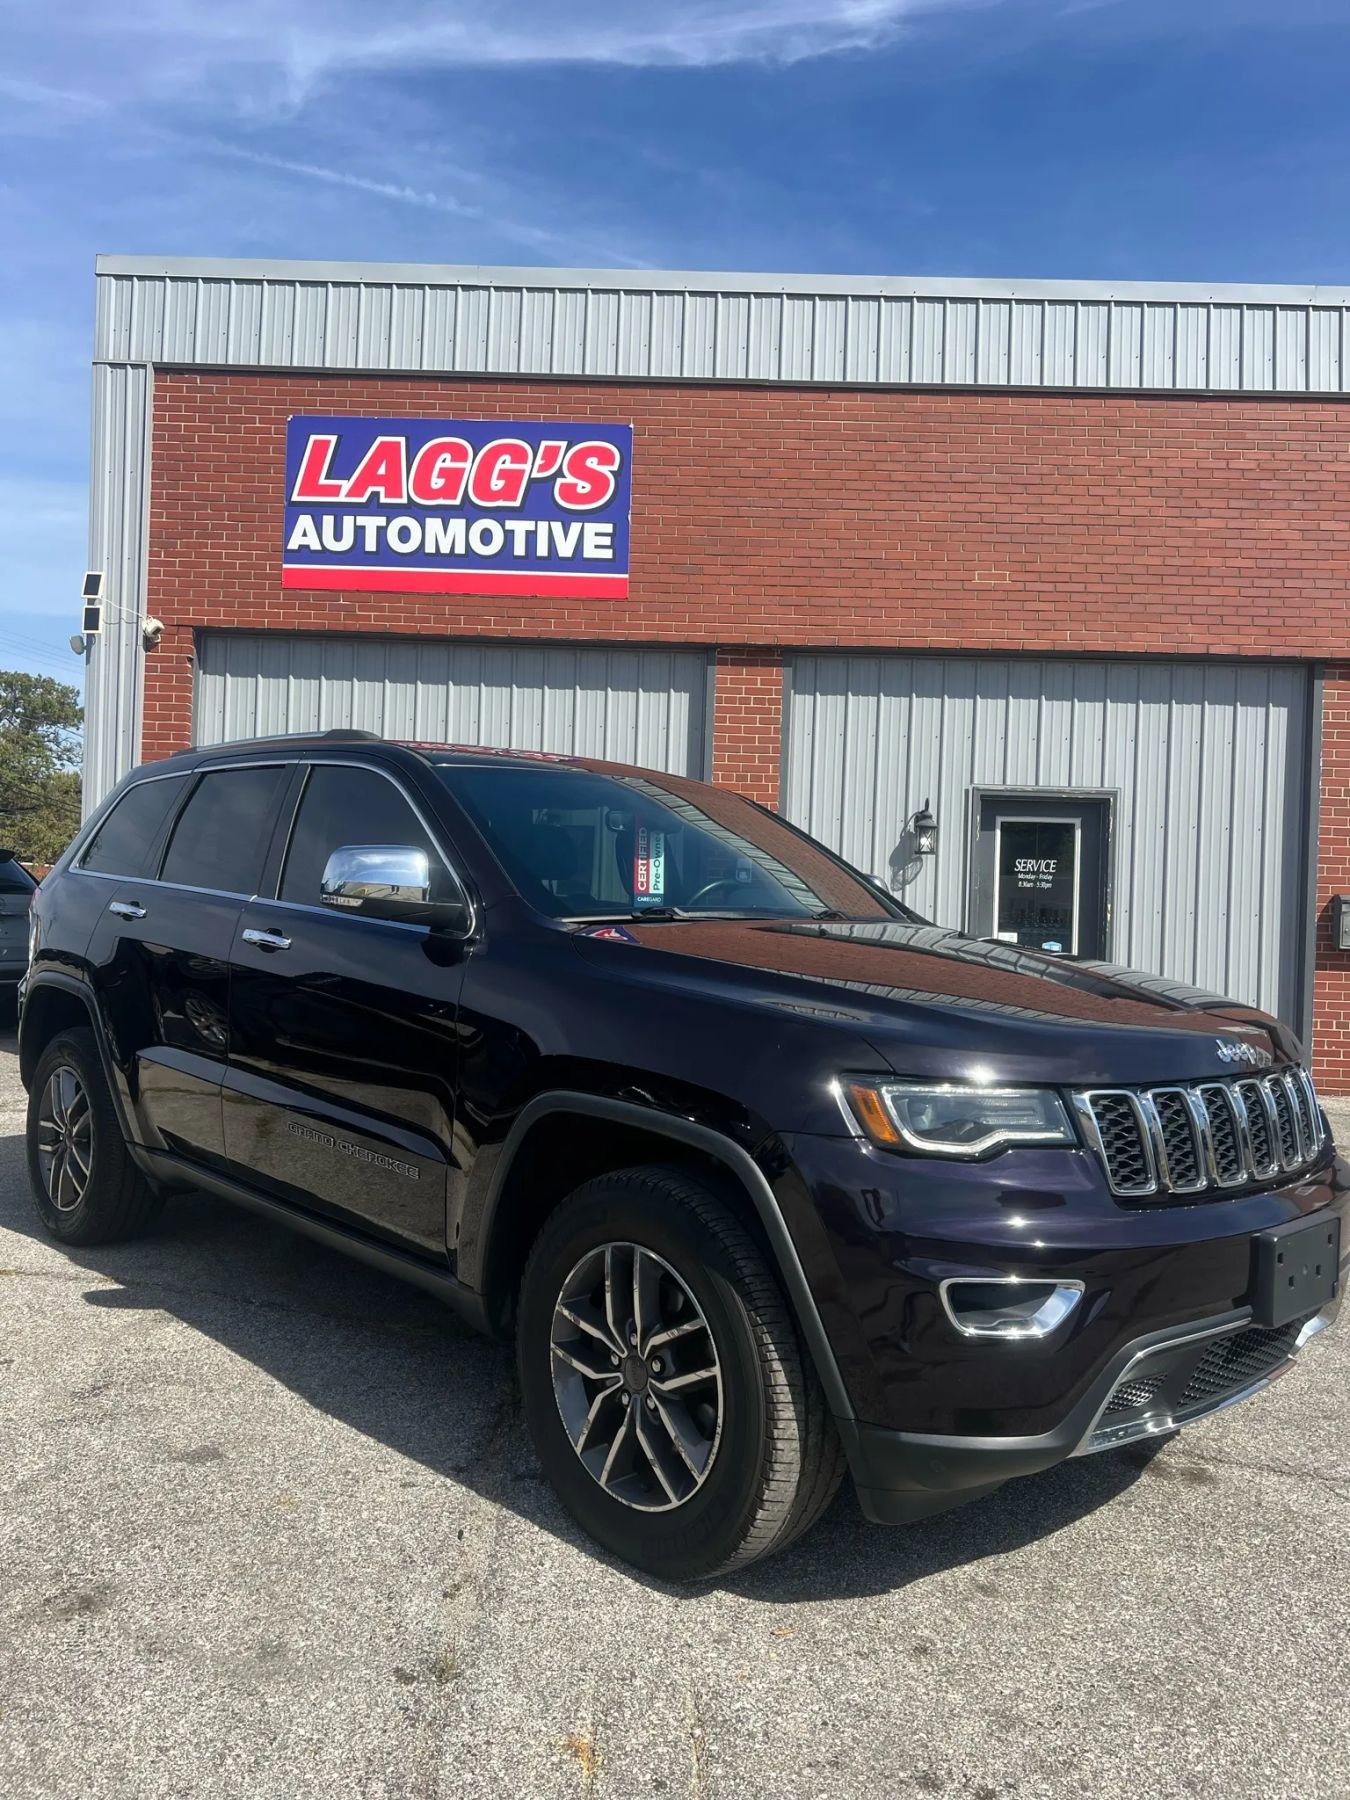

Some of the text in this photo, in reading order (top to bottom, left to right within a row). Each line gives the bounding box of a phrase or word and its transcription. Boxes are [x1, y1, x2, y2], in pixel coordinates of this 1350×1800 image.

[291, 434, 620, 510] LAGG'S
[286, 514, 614, 559] AUTOMOTIVE
[638, 827, 647, 890] CERTIFIED
[1014, 859, 1057, 872] SERVICE
[1039, 873, 1053, 881] Friday
[1216, 1039, 1257, 1064] Jeep
[287, 1121, 420, 1180] GRAND CHEROKEE
